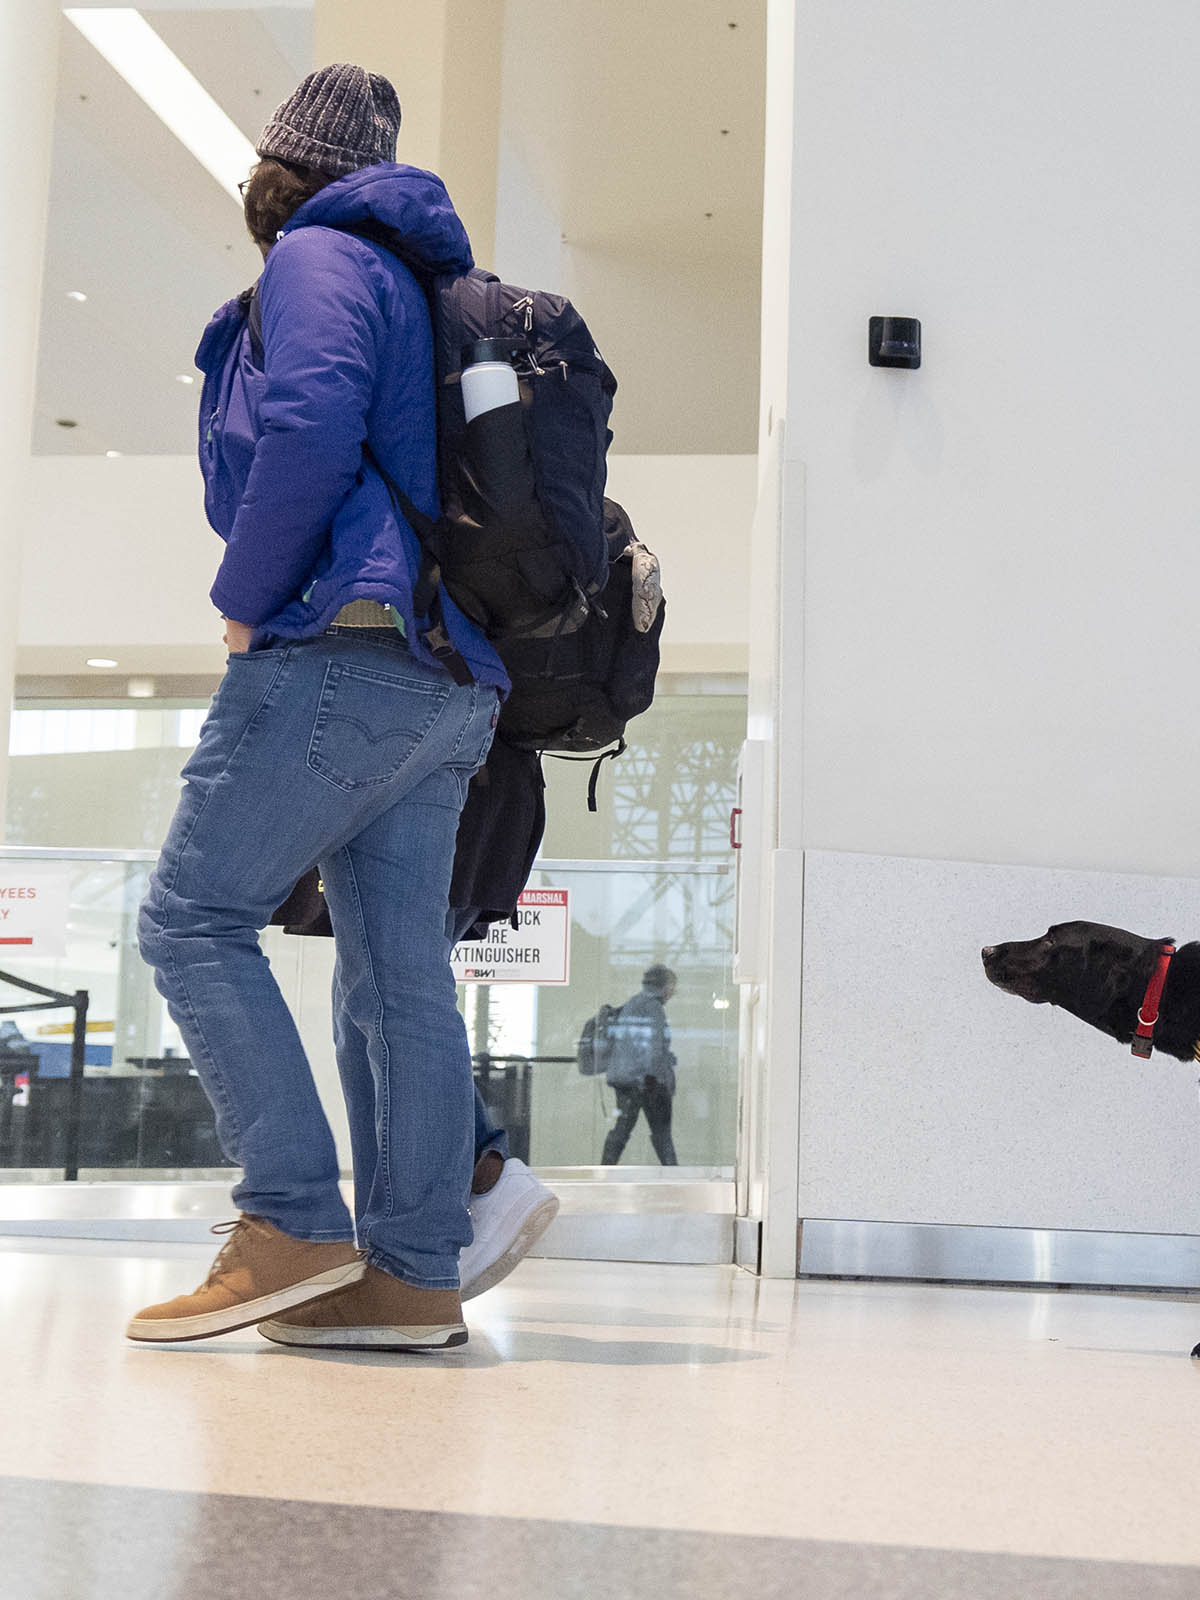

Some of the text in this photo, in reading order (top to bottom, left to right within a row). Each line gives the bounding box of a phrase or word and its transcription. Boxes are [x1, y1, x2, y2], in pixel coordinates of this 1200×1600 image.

[522, 892, 564, 905] MARSHAL
[499, 910, 541, 926] OCK
[480, 929, 508, 944] IRE
[449, 947, 541, 963] XTINGUISHER
[474, 968, 496, 978] BWI
